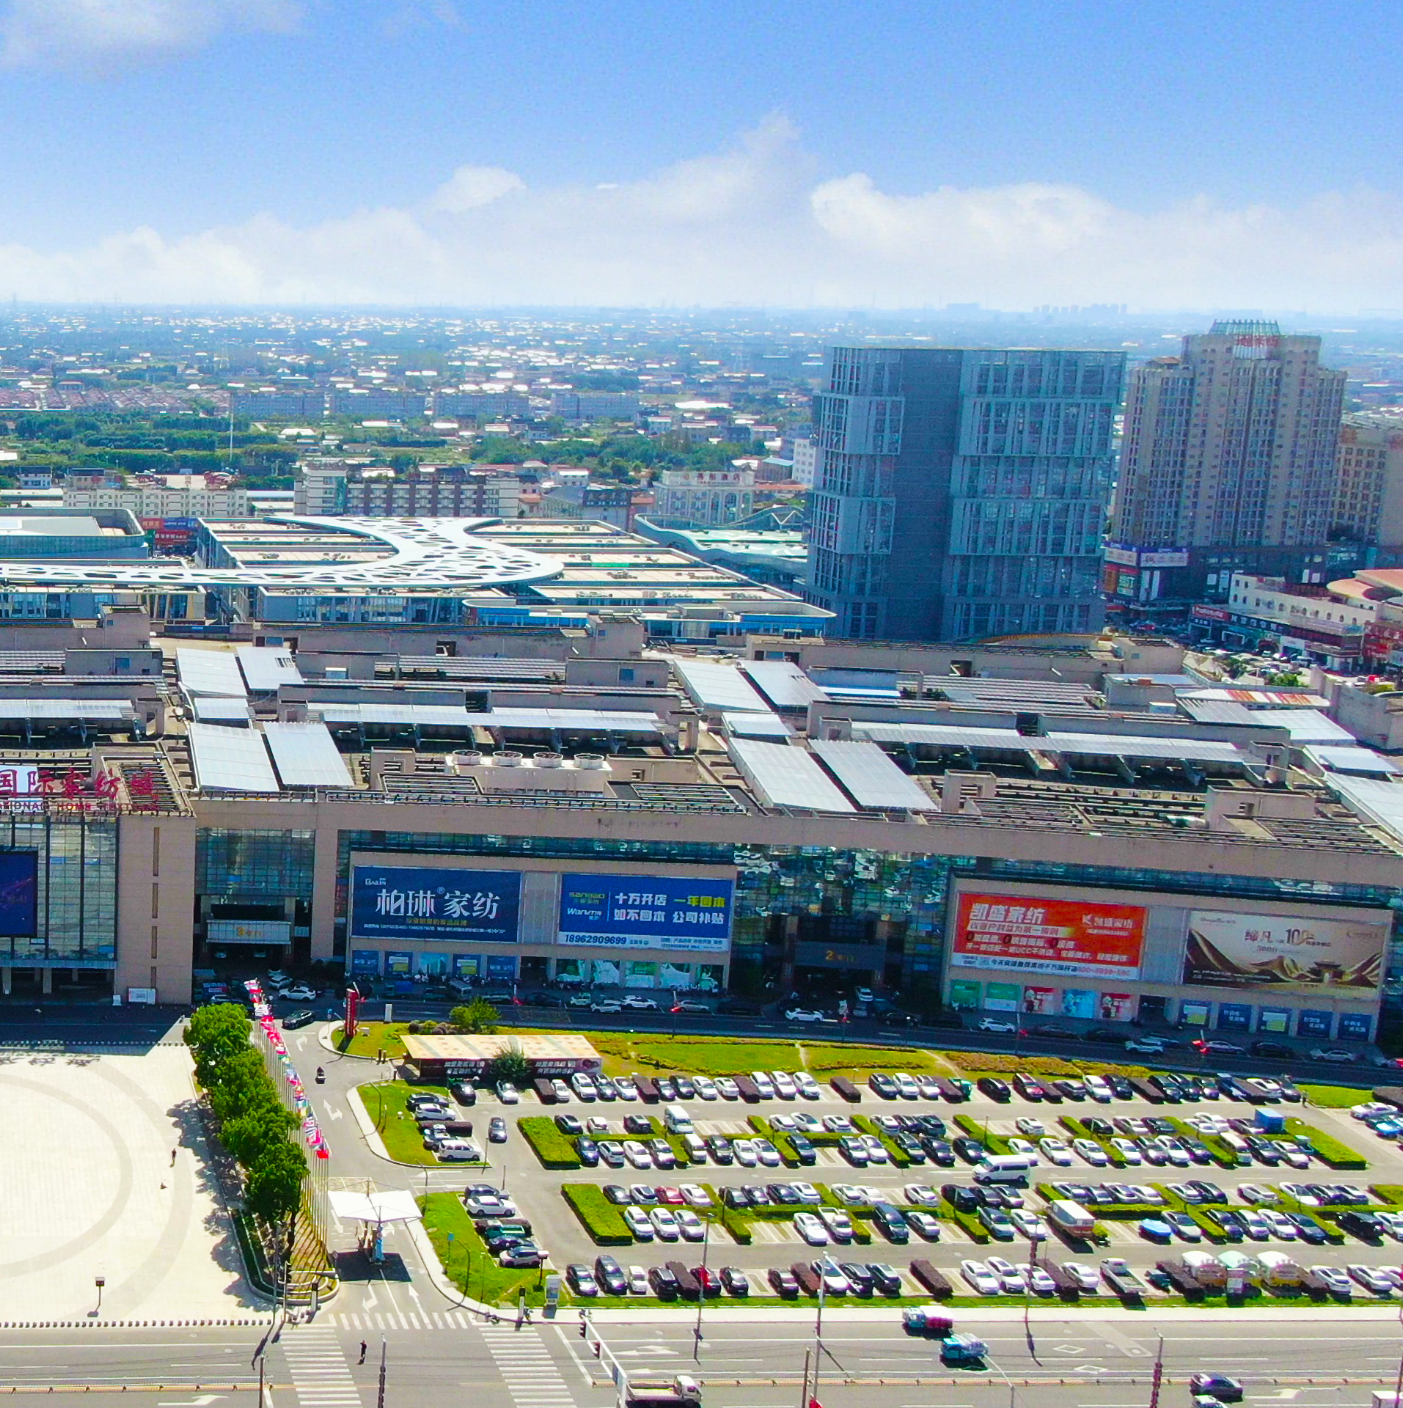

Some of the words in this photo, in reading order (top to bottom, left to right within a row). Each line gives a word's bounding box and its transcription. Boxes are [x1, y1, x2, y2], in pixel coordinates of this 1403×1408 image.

[615, 892, 667, 906] 十万开店
[613, 908, 666, 922] 如不回本
[672, 911, 725, 925] 公司补贴
[969, 903, 1046, 924] 凯盛家纺
[565, 934, 627, 945] 18962909699
